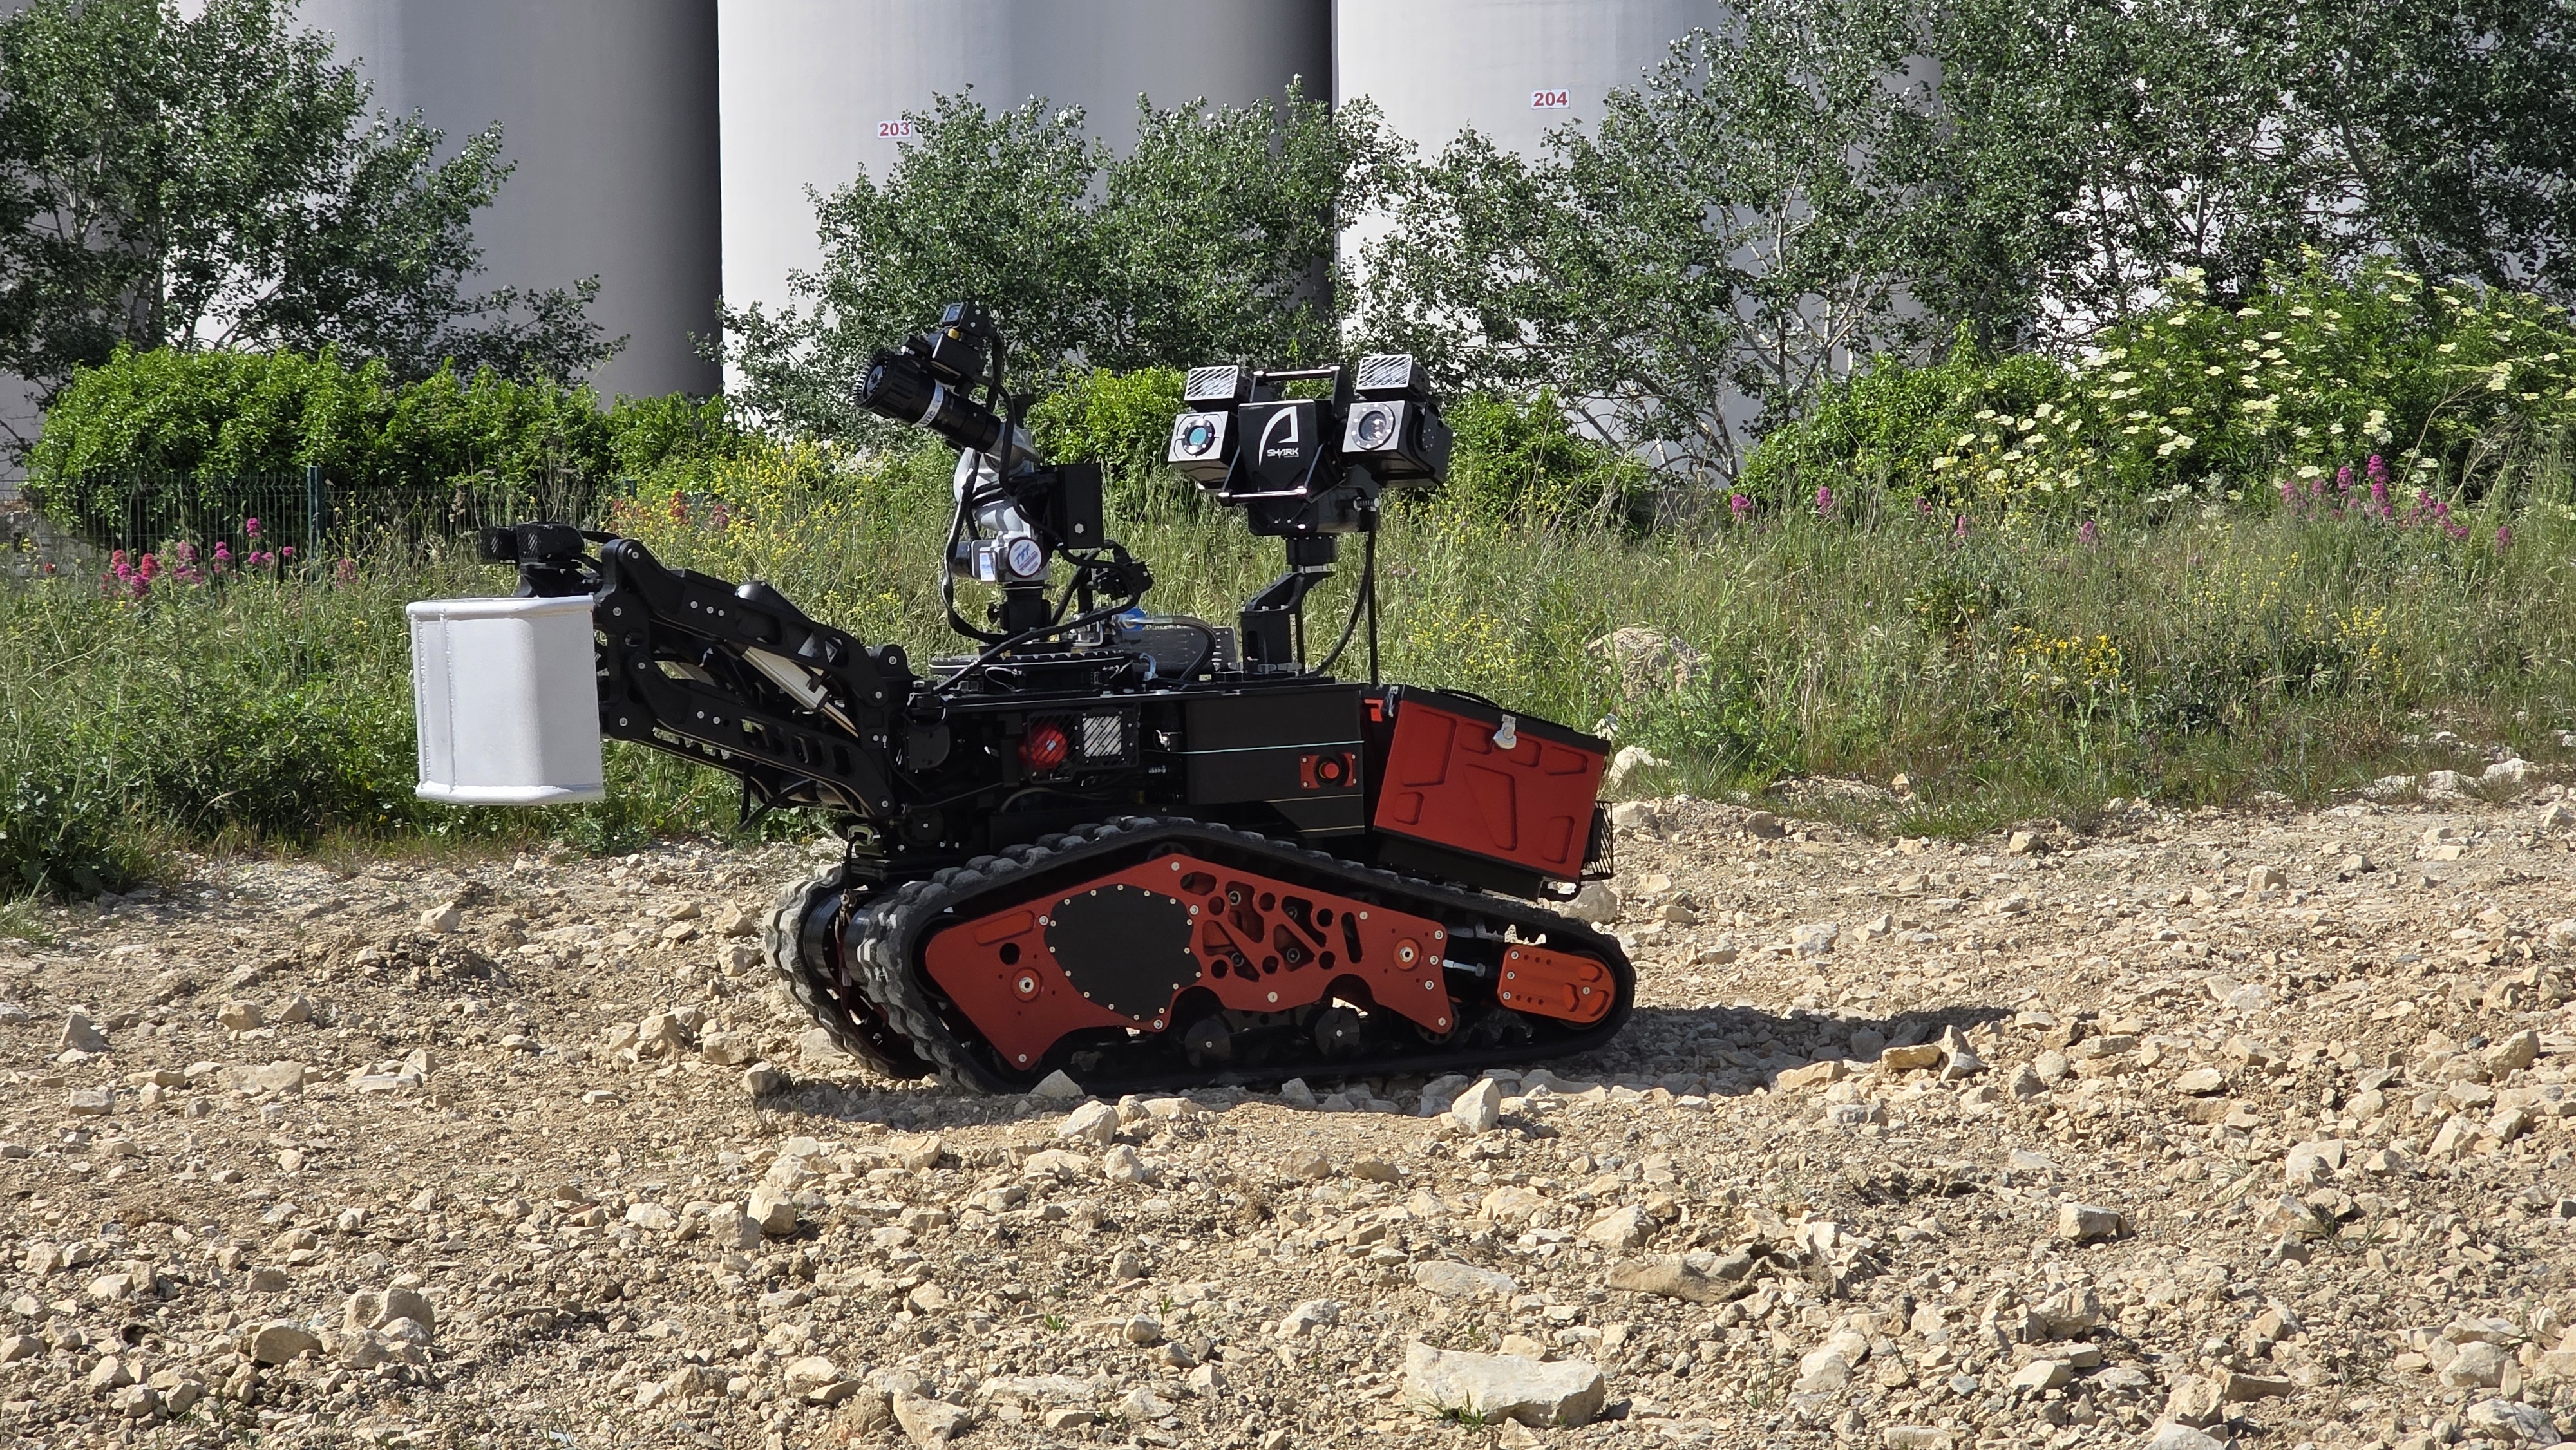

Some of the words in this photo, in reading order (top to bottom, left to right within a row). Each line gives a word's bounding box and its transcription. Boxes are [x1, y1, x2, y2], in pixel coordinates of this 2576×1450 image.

[1533, 91, 1567, 107] 204
[879, 122, 910, 137] 203
[1267, 447, 1299, 458] SHARK
